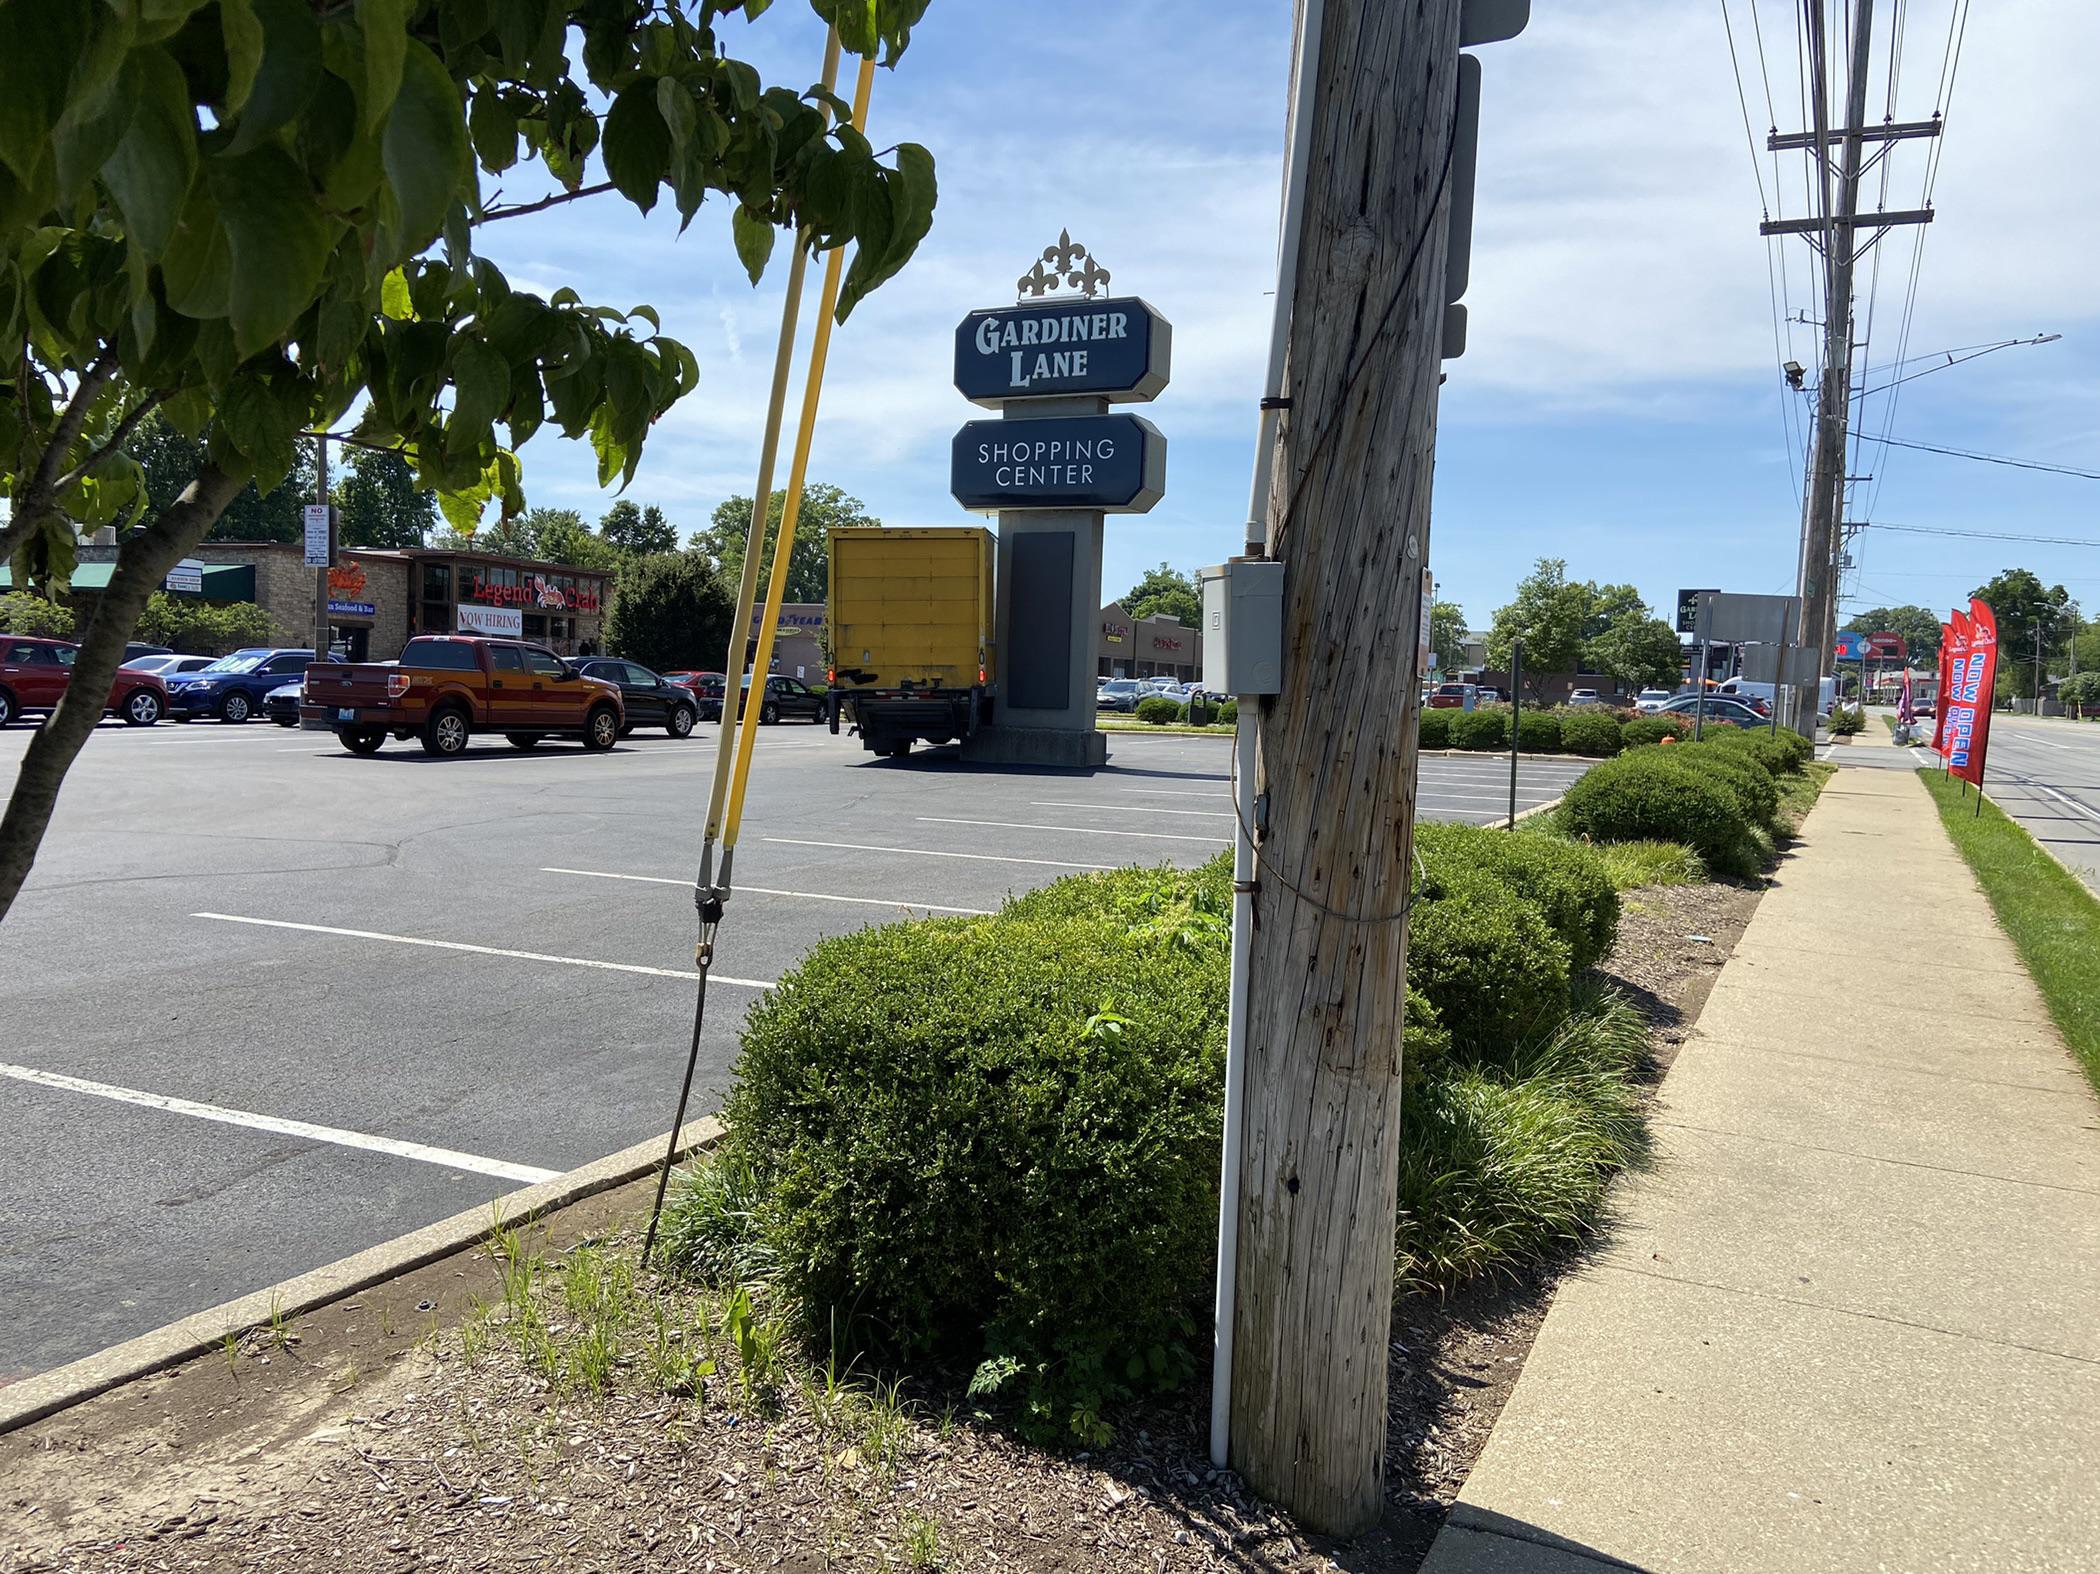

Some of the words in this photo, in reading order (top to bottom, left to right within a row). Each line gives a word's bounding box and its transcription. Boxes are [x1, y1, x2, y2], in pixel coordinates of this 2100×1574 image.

[975, 313, 1127, 355] GARDINER
[1010, 350, 1088, 387] LANE
[978, 439, 1115, 463] SHOPPING
[996, 464, 1093, 487] CENTER
[473, 575, 533, 607] Legend
[565, 587, 598, 610] Crab
[460, 611, 483, 626] NOW
[485, 613, 521, 629] HIRING
[1951, 658, 1965, 702] NOW
[1962, 652, 1986, 703] NOW
[1950, 708, 1975, 767] OPEN
